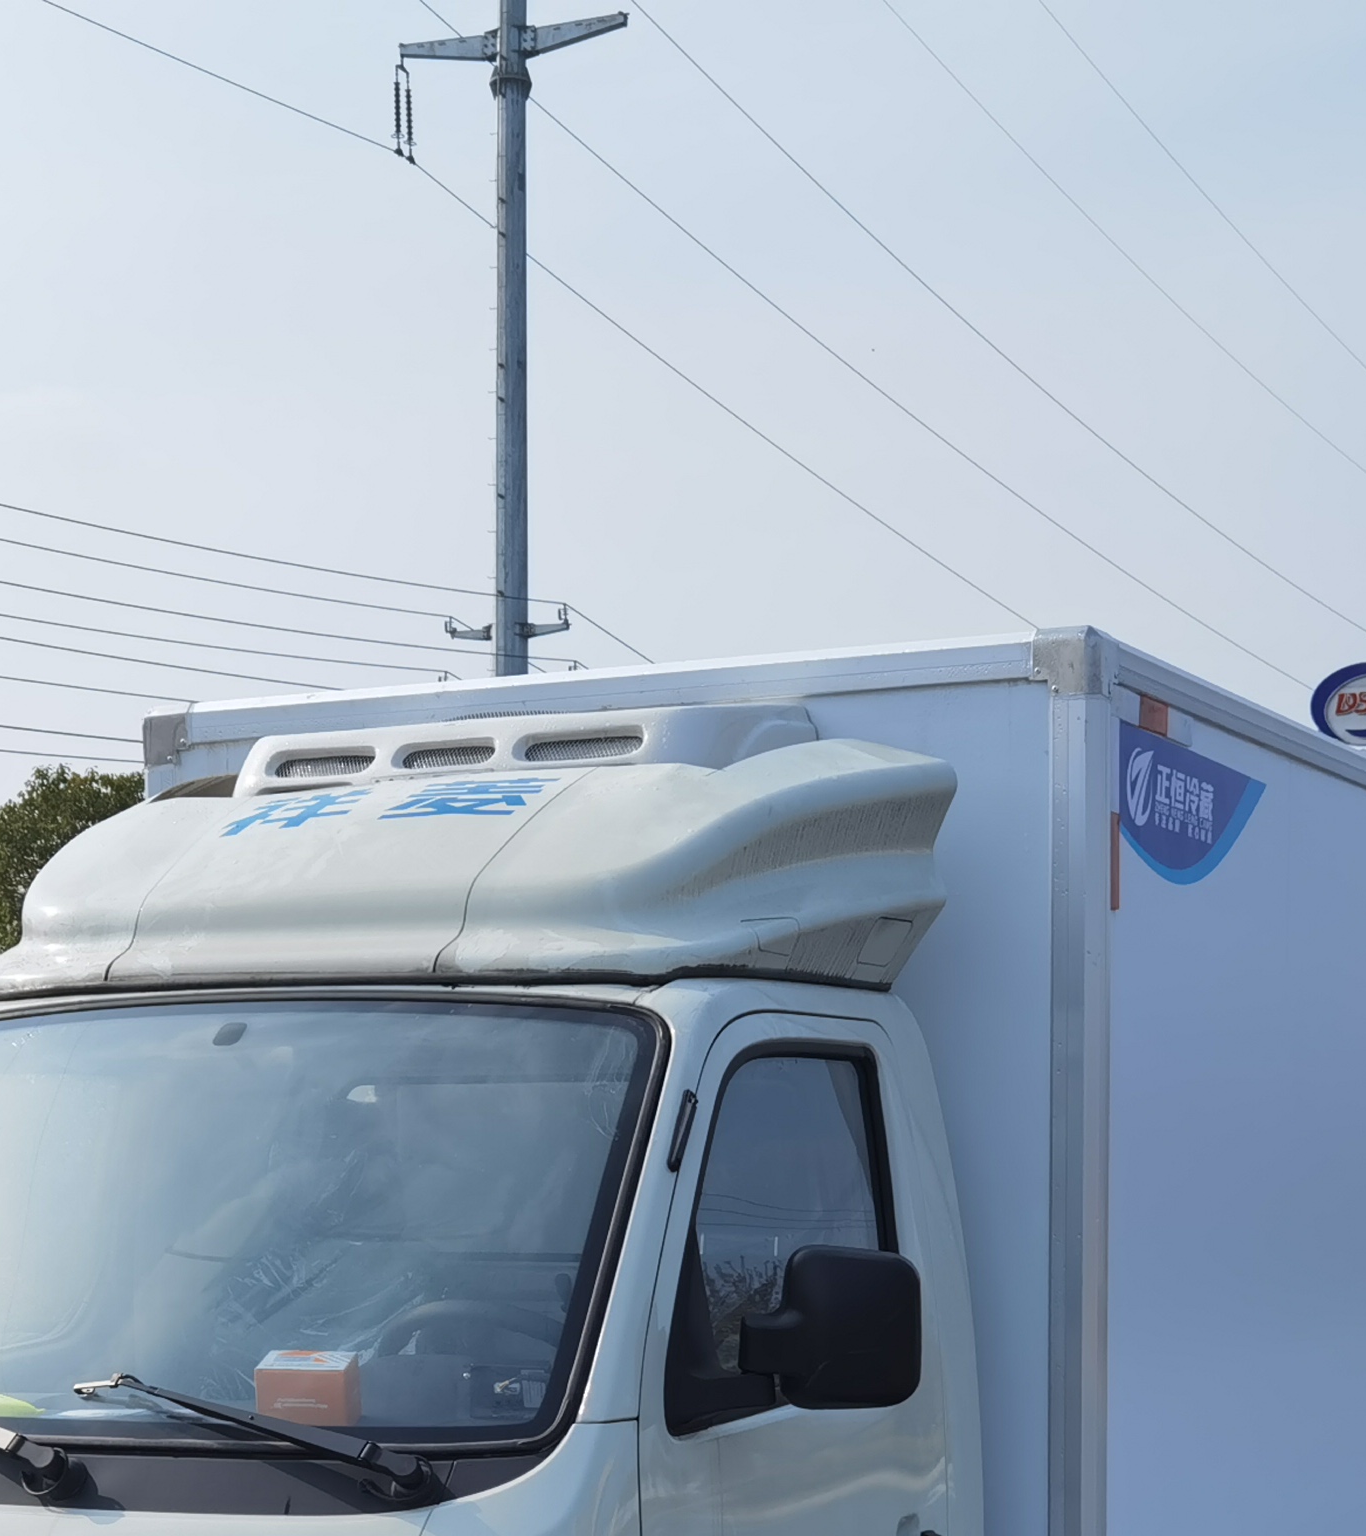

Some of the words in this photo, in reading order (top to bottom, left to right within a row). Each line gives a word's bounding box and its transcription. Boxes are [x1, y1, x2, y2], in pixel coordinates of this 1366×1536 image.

[220, 777, 561, 837] 祥菱
[1154, 763, 1215, 822] 正恒冷藏
